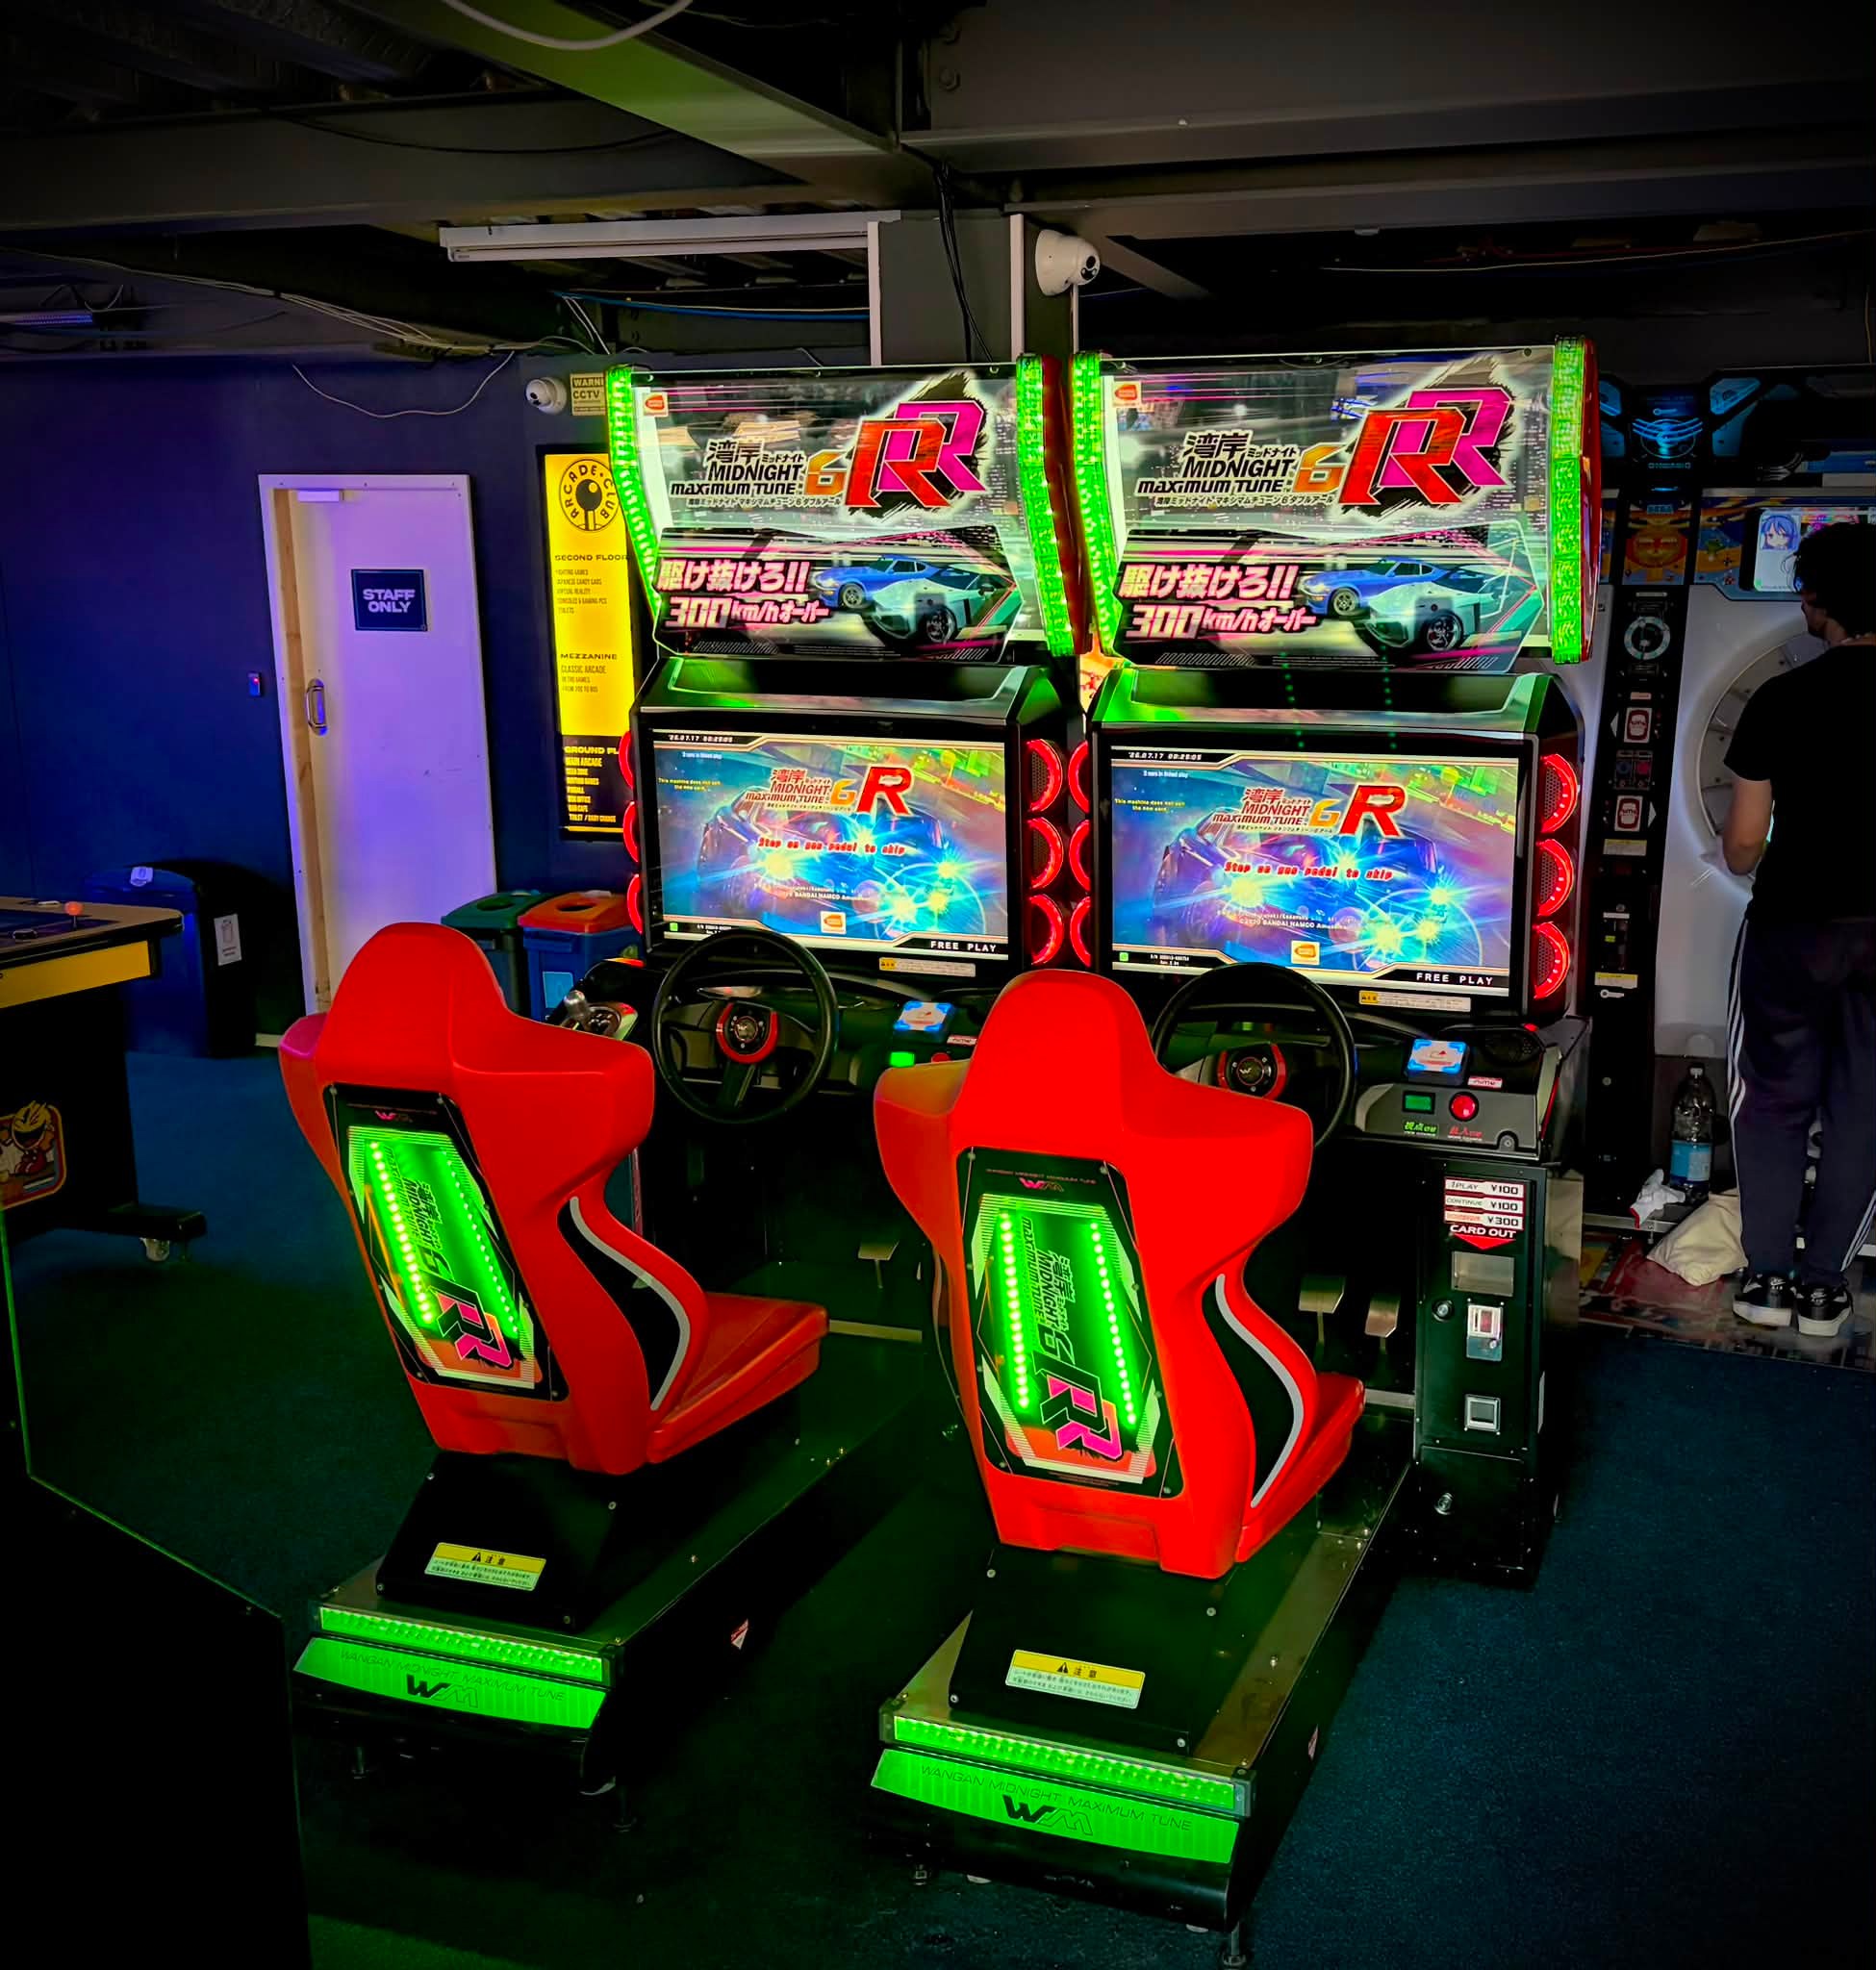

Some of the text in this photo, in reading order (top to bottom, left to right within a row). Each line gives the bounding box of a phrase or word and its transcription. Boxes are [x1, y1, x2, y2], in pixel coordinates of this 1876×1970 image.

[573, 391, 600, 399] CCTV
[706, 440, 763, 464] 湾岸
[1183, 434, 1249, 459] 湾岸
[707, 461, 803, 481] MIDNIGHT
[804, 450, 849, 495] 6
[1182, 454, 1295, 478] MIDNIGHT
[1293, 442, 1344, 493] 6
[363, 589, 416, 600] STAFF
[368, 601, 411, 613] ONLY
[564, 745, 605, 754] GROUND
[771, 780, 830, 796] MIDNIGHT
[831, 778, 858, 806] 6
[857, 766, 913, 817] R
[1241, 800, 1310, 817] MIDNIGHT
[1308, 799, 1341, 827] 6
[1339, 784, 1406, 837] R
[1225, 861, 1251, 873] Step
[1262, 919, 1288, 928] BANDAI
[1290, 921, 1315, 929] NAMCO
[930, 940, 997, 952] FREE PLAY
[1416, 972, 1494, 986] FREE PLAY
[1447, 1198, 1483, 1206] CONTINUE
[1450, 1225, 1516, 1238] CARD OUT
[1036, 1249, 1060, 1332] MIDNIGHT
[341, 1651, 566, 1703] WANGAN MIDNIGHT MAXIMUM TUNE
[921, 1764, 1192, 1832] WANGAN MIDNIGHT MAXIMUM TUNE
